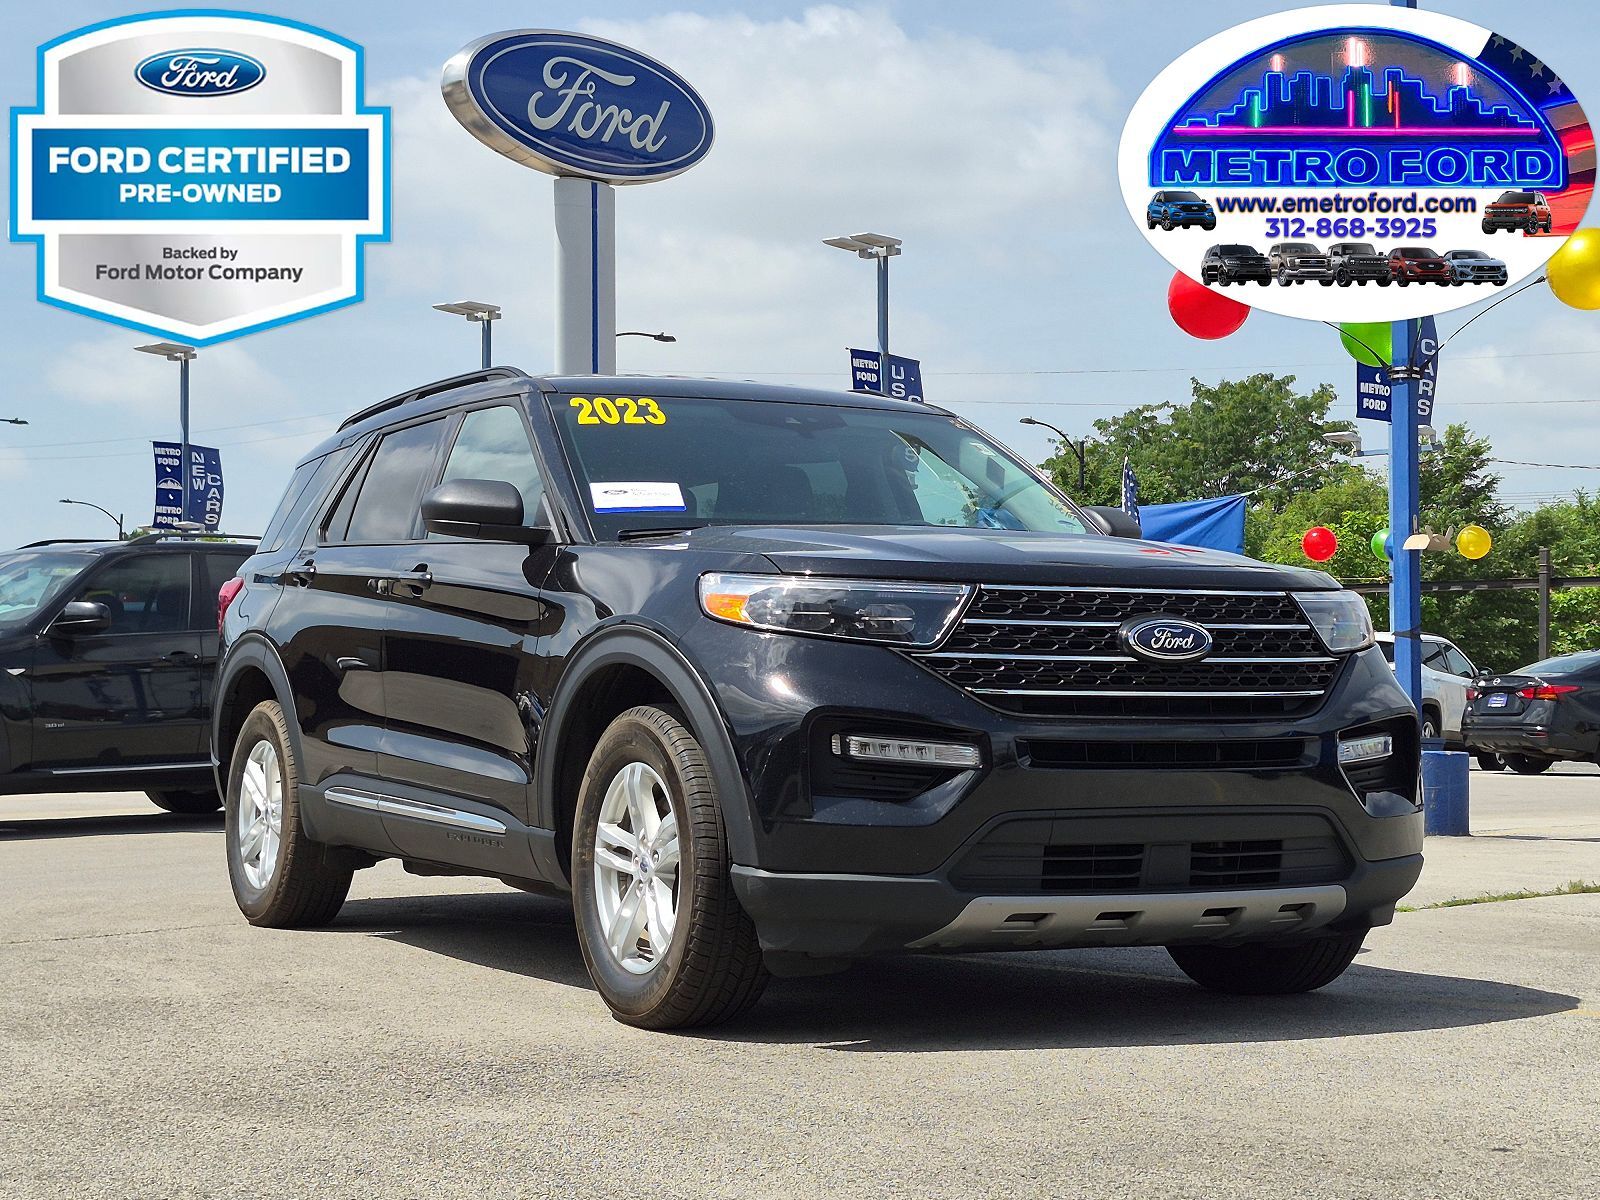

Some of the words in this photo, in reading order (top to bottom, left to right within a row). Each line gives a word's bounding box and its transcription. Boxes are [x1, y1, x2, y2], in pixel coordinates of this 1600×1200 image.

[527, 55, 671, 153] Ford
[852, 358, 879, 370] METRO
[856, 371, 878, 383] FORD
[1360, 382, 1391, 397] METRO
[569, 396, 667, 425] 2023
[1362, 397, 1387, 411] FORD
[154, 447, 181, 456] METRO
[157, 457, 180, 466] FORD
[191, 451, 206, 491] NEW
[204, 474, 222, 525] CARS
[155, 505, 182, 515] METRO
[156, 516, 180, 524] FORD
[1150, 627, 1195, 649] Ford
